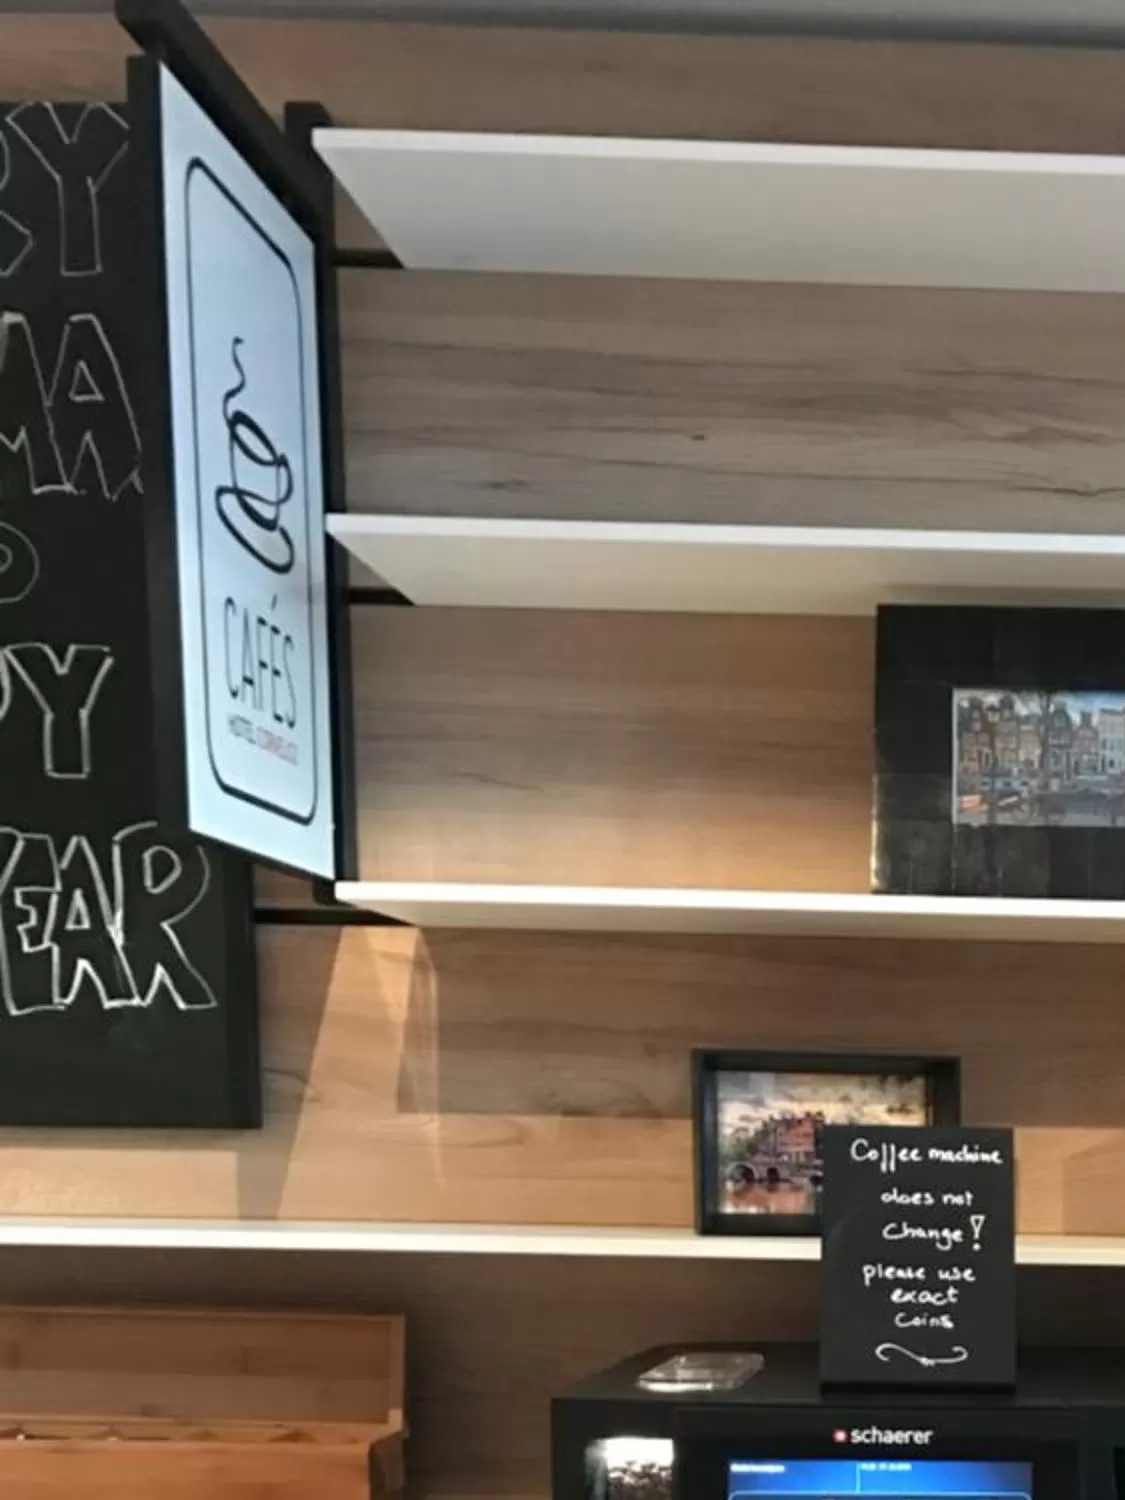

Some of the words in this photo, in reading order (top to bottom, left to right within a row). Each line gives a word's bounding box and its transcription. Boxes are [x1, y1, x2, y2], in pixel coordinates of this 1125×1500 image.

[0, 100, 132, 277] Y
[0, 643, 114, 778] Y
[0, 820, 218, 1016] EAR
[851, 1138, 922, 1173] Coffee
[928, 1144, 1003, 1164] machine
[880, 1188, 934, 1204] does
[942, 1191, 974, 1205] not
[862, 1264, 925, 1287] please
[938, 1268, 976, 1282] use
[890, 1286, 959, 1305] exact
[851, 1426, 934, 1445] schaerer
